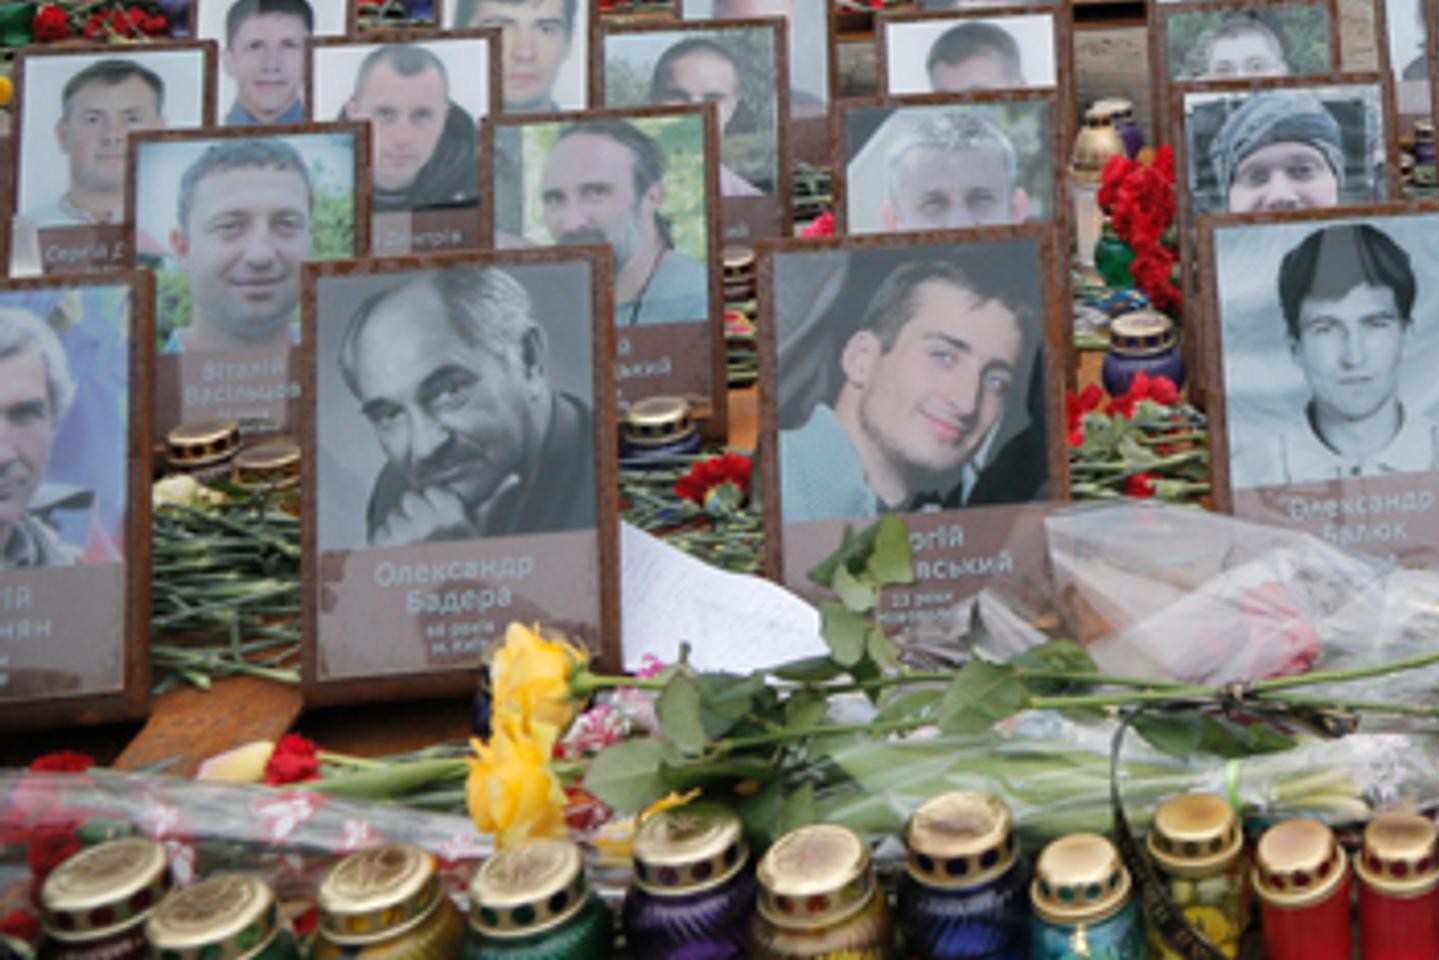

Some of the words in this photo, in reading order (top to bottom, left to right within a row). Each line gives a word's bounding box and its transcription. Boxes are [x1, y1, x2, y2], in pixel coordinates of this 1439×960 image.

[373, 555, 535, 588] Олександр
[915, 549, 1014, 581] вський
[405, 587, 512, 615] Бадера
